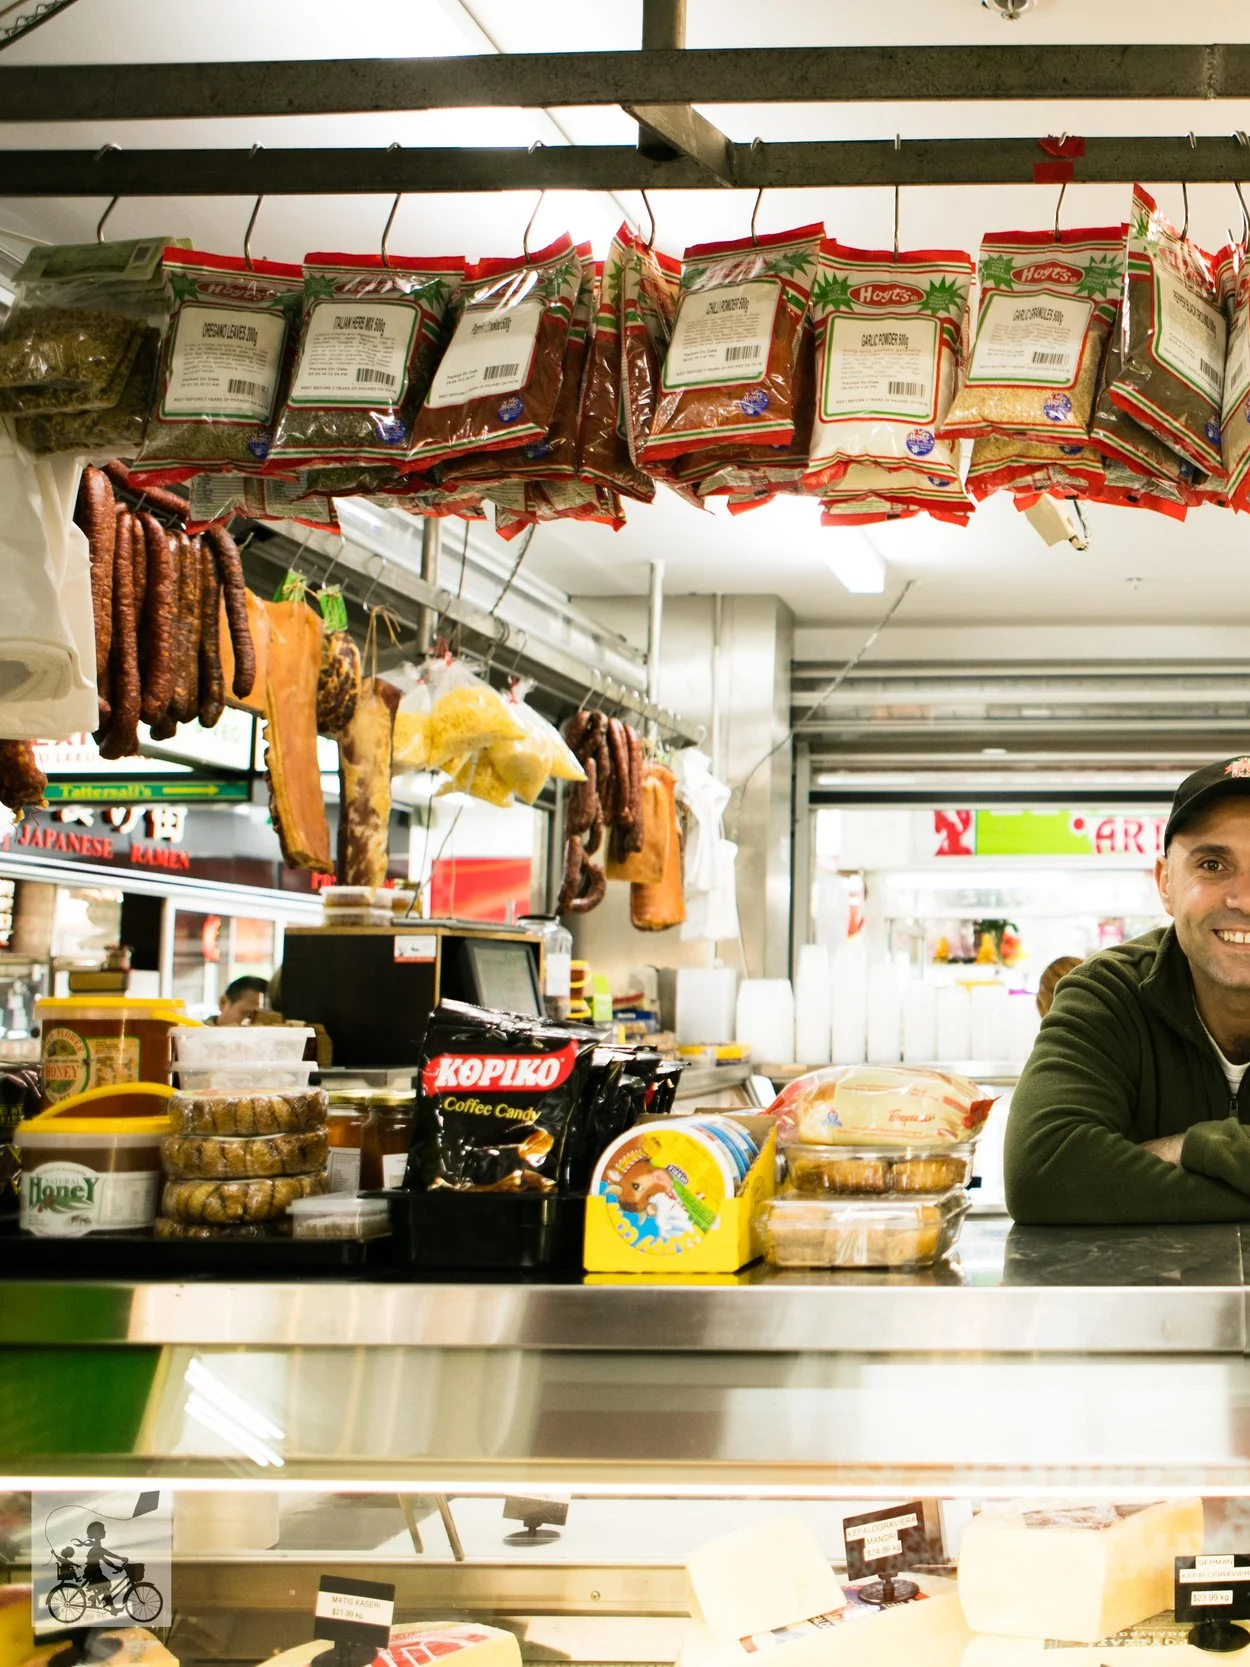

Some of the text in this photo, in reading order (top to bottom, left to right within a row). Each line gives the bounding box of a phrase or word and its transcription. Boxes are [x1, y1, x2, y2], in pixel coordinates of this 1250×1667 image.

[1021, 266, 1072, 282] Hoyt's
[860, 286, 912, 302] Hoyt's
[333, 316, 352, 330] ITALIAN
[352, 316, 366, 330] HERB
[202, 323, 227, 339] OREGANO
[227, 325, 246, 342] LEAVES
[862, 332, 909, 350] GARLIC POWDER 500g
[18, 824, 190, 870] JAPANESE RAMEN
[45, 1065, 77, 1078] HONEY
[435, 1057, 560, 1087] KOPIKO
[444, 1097, 541, 1124] Coffee Candy
[848, 1516, 916, 1537] KEFALOGRAVIERA
